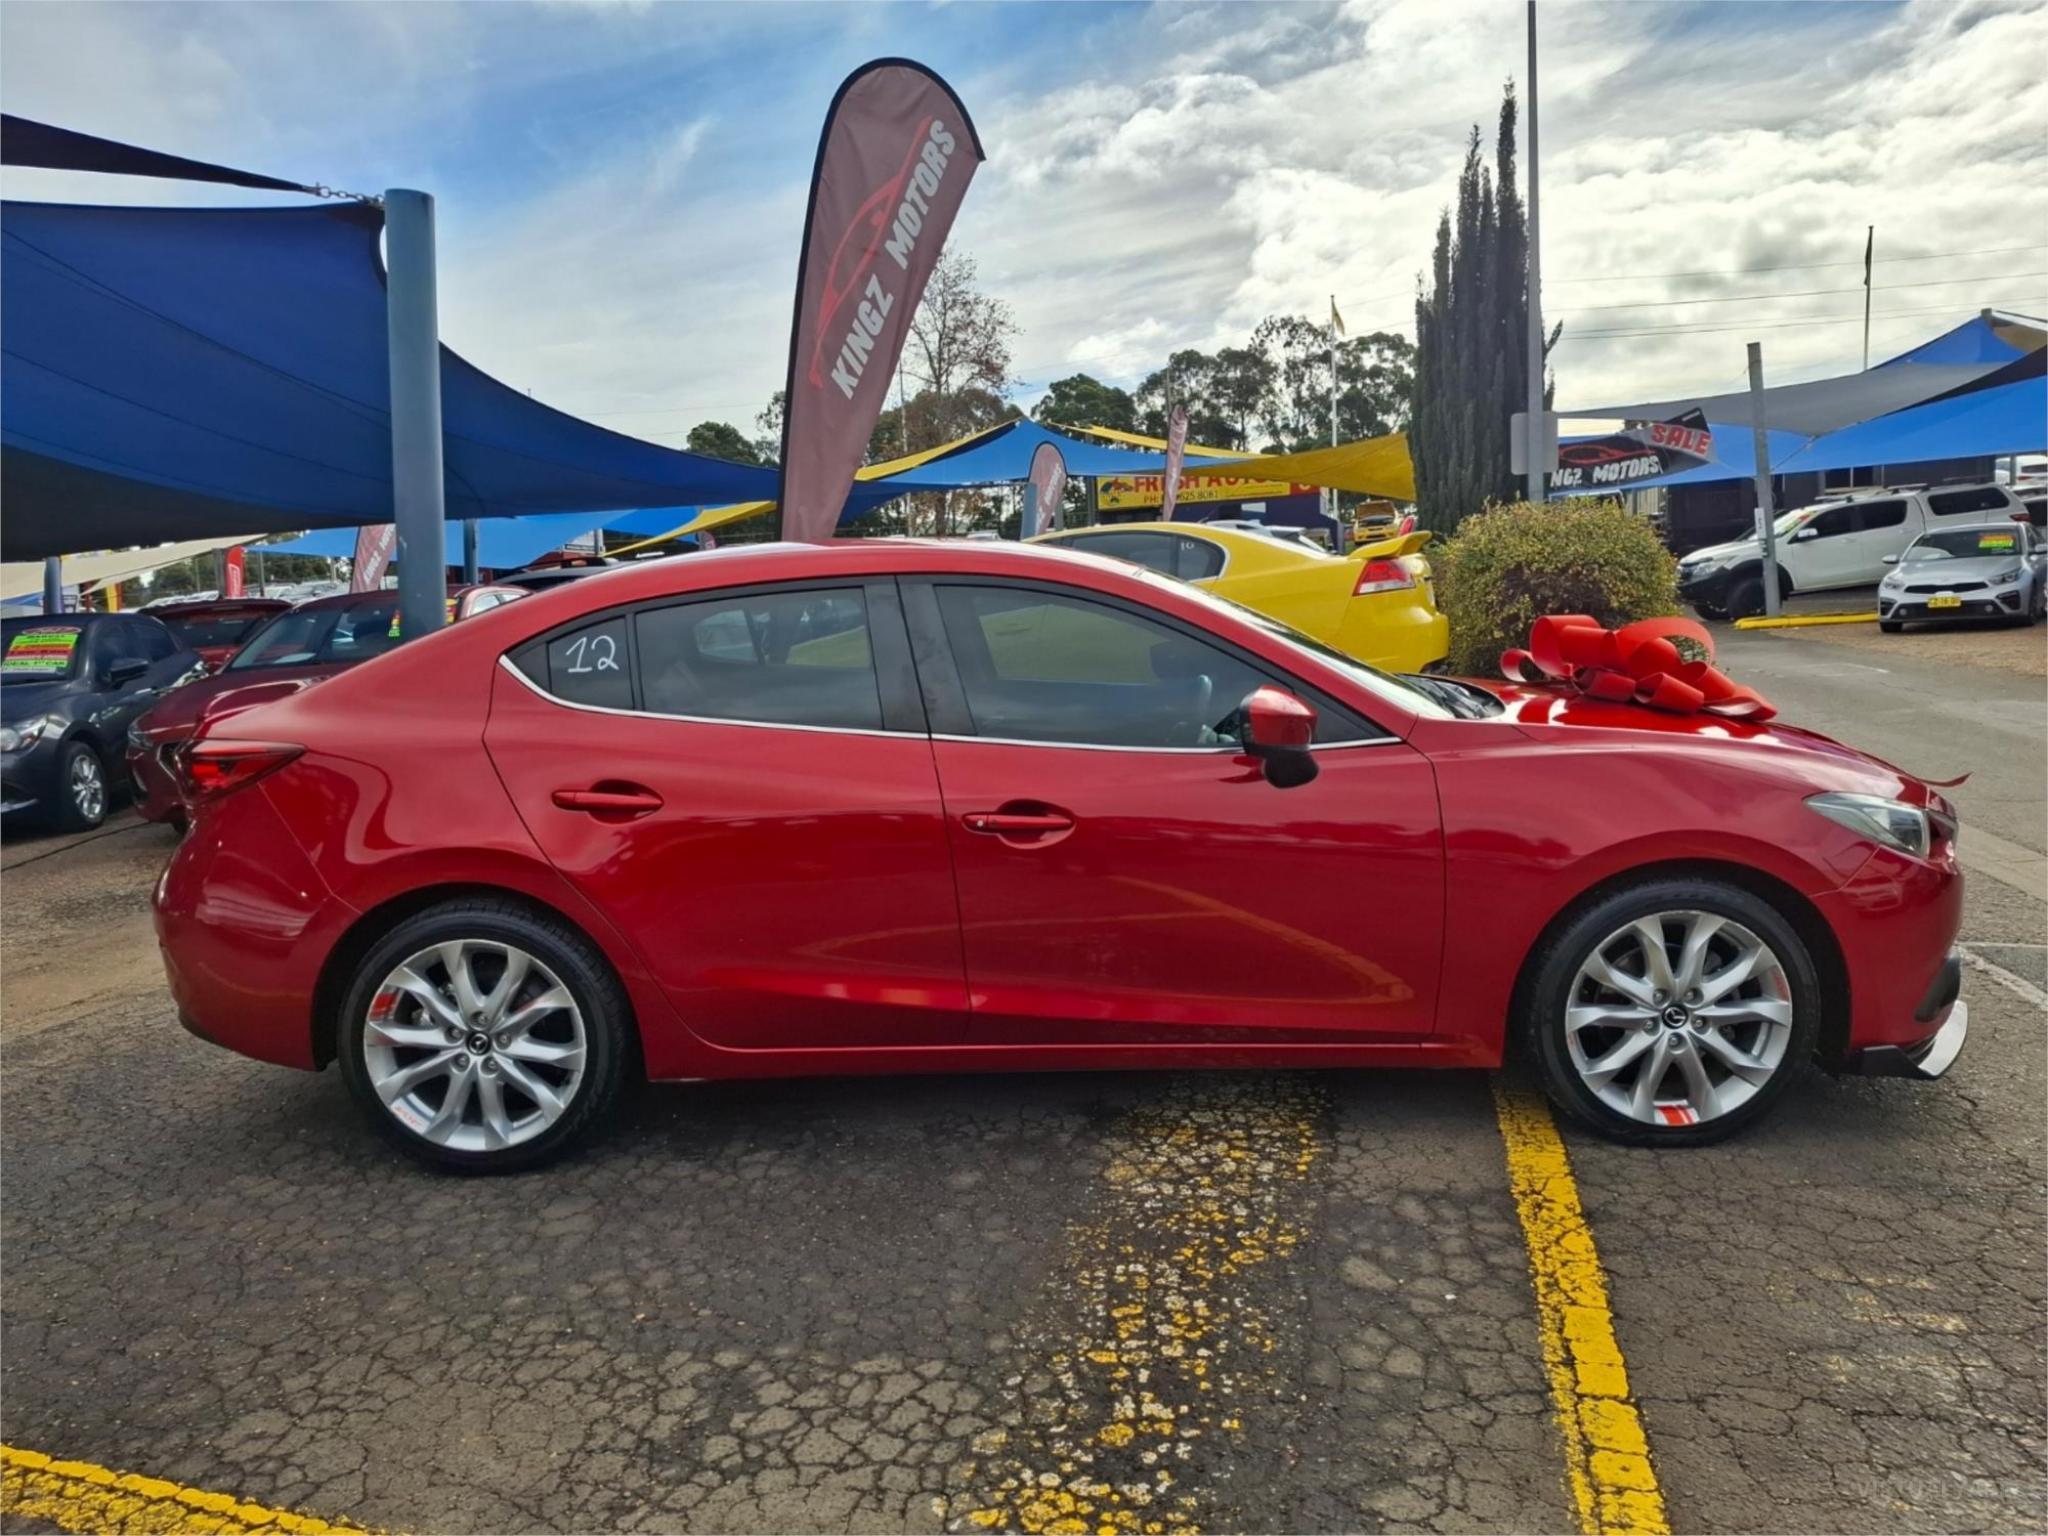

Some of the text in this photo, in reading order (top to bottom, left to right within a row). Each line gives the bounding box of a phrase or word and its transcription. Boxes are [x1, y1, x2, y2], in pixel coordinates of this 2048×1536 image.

[831, 119, 957, 401] KINGZ MOTORS
[1651, 422, 1712, 456] SALE
[1550, 454, 1660, 488] NGZ MOTORS
[565, 634, 619, 673] 12
